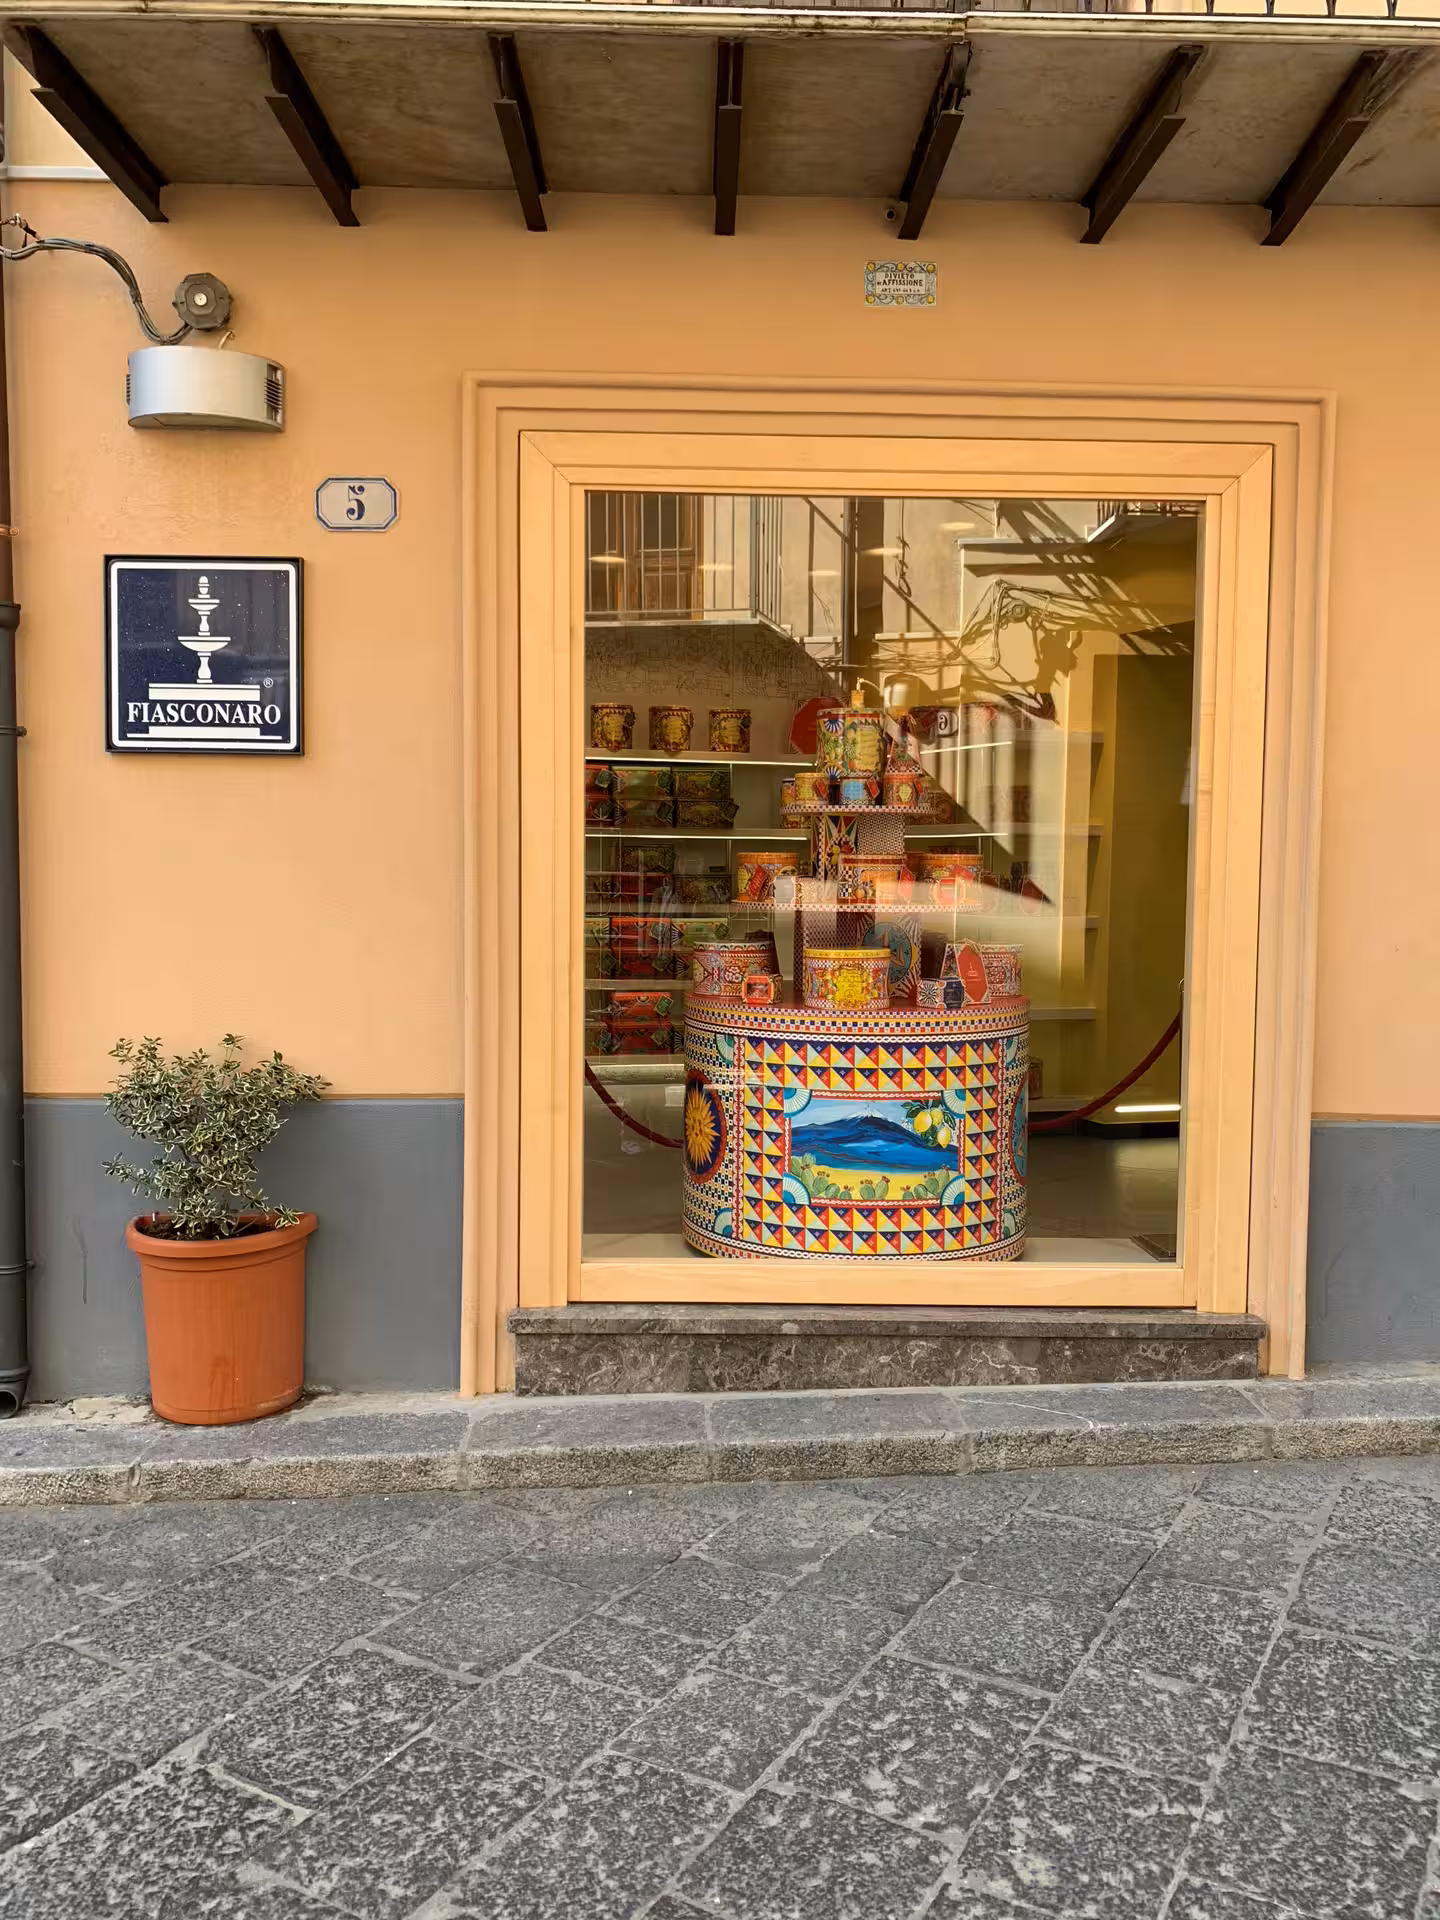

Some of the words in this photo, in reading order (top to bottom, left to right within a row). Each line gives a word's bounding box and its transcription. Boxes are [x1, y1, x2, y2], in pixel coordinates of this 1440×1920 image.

[882, 279, 923, 287] AFFISSIONE
[346, 484, 366, 521] 5
[127, 702, 281, 725] FIASCONARO
